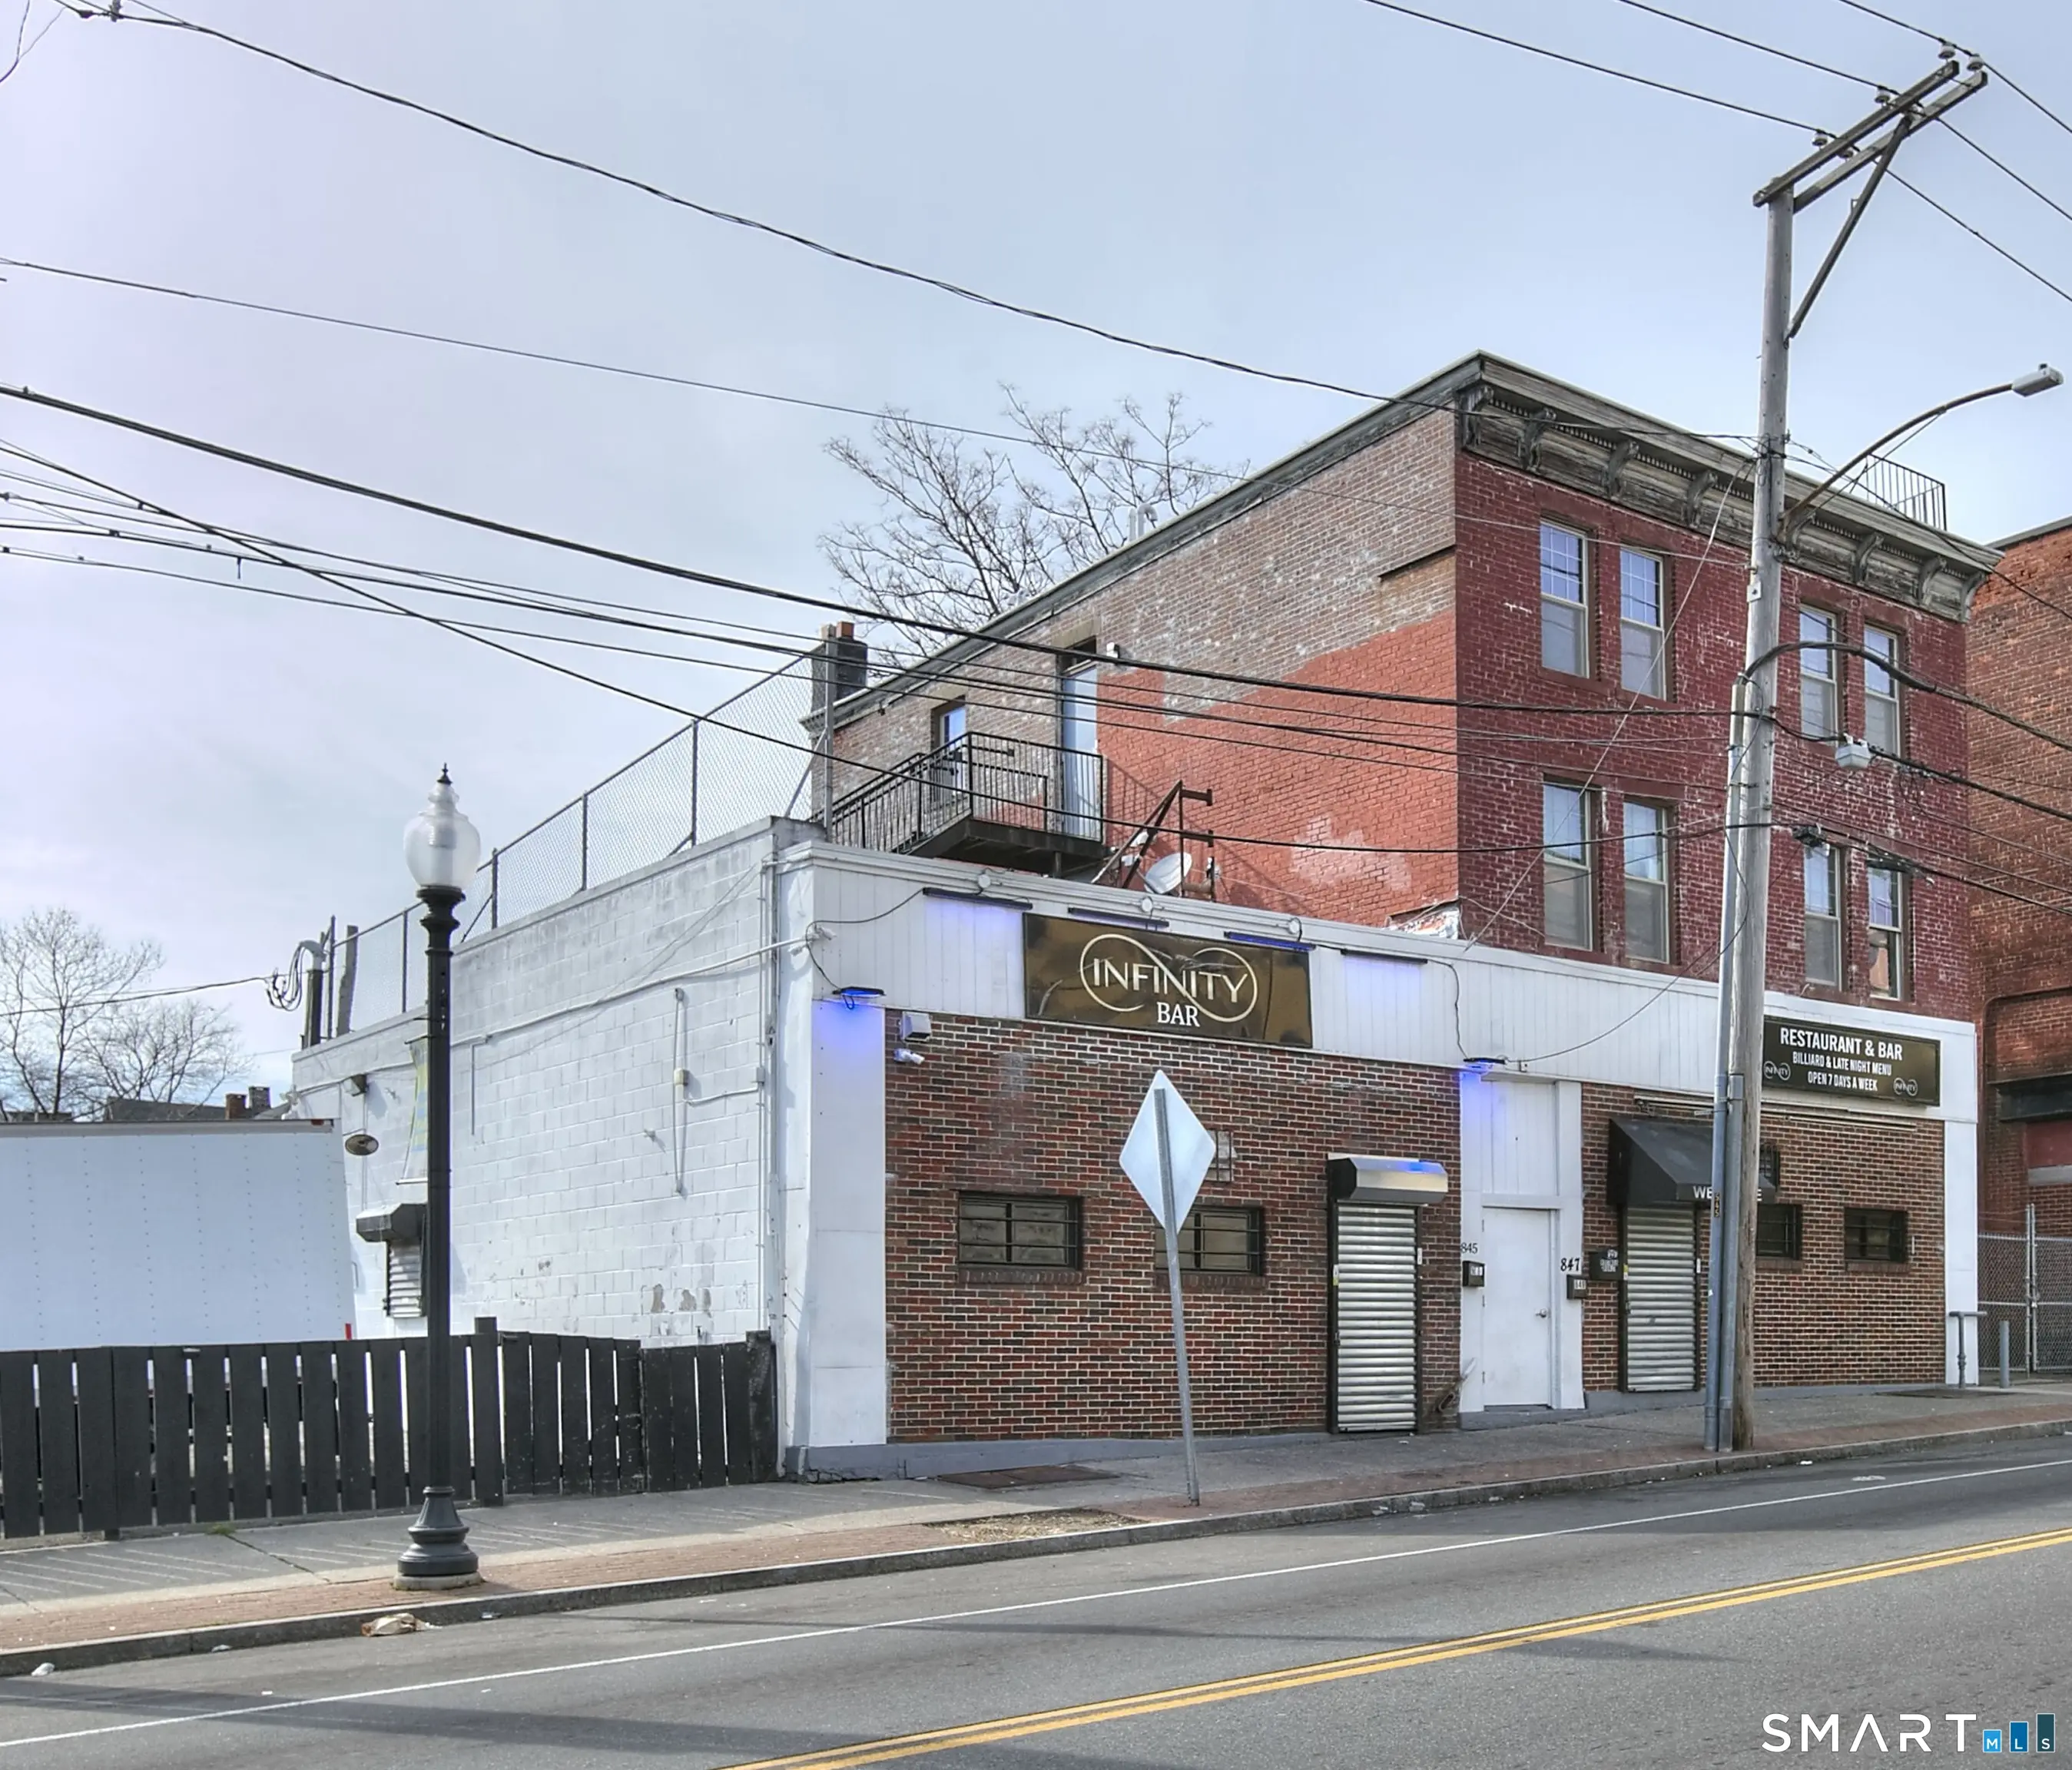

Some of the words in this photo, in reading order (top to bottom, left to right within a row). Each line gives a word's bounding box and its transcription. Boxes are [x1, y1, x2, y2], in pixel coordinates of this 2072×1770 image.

[1093, 957, 1248, 1003] INFINITY
[1156, 1001, 1200, 1027] BAR
[1780, 1027, 1861, 1056] RESTAURANT
[1865, 1040, 1875, 1057] &
[1878, 1042, 1903, 1061] BAR
[1792, 1051, 1825, 1068] BILLIARD
[1825, 1056, 1832, 1068] &
[1832, 1057, 1850, 1071] LATE
[1850, 1059, 1871, 1074] NIGHT
[1872, 1062, 1892, 1076] MENU
[1808, 1071, 1827, 1086] OPEN
[1828, 1073, 1833, 1086] 7
[1833, 1074, 1852, 1089] DAYS
[1852, 1076, 1858, 1089] A
[1858, 1076, 1878, 1092] WEEK
[1460, 1242, 1478, 1254] 845
[1560, 1258, 1580, 1271] 847
